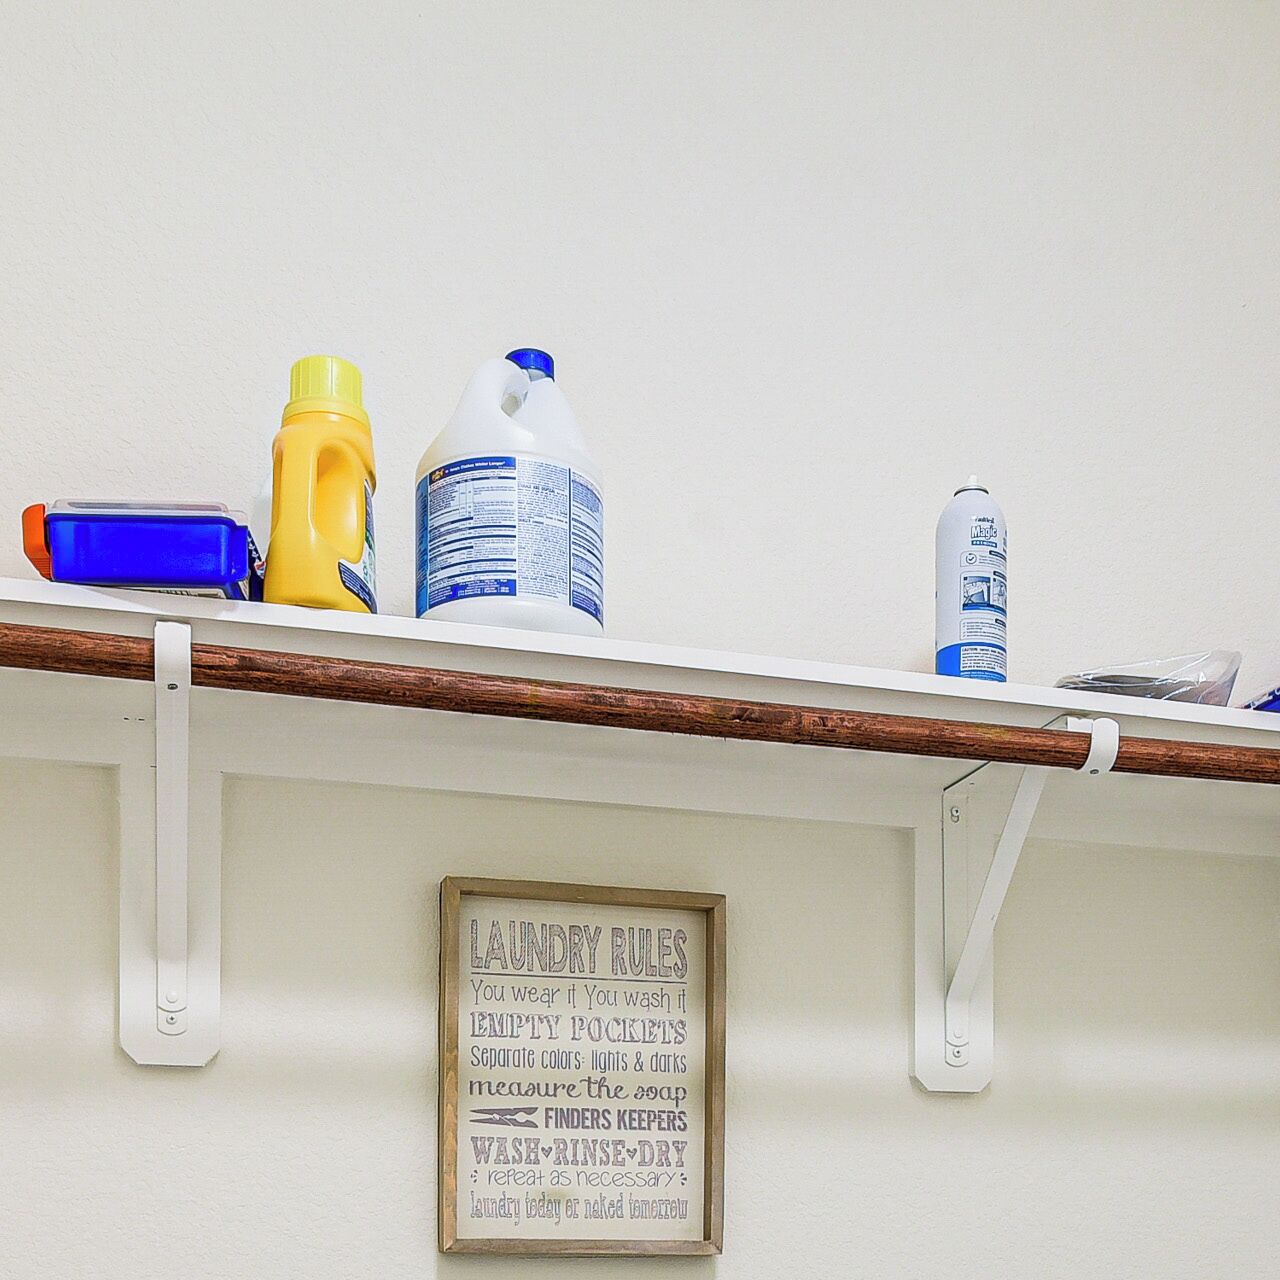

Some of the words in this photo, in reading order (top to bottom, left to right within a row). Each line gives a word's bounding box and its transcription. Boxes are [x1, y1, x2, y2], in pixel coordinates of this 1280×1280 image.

[971, 525, 997, 540] Magic
[471, 919, 602, 974] LAUNDRY
[611, 927, 688, 979] RULES
[470, 979, 505, 1005] You
[512, 986, 560, 1008] wear
[568, 983, 576, 1008] it
[584, 984, 617, 1010] You
[624, 988, 670, 1013] wash
[678, 989, 686, 1013] it
[470, 1011, 562, 1040] EMPTY
[571, 1016, 688, 1045] POCKETS
[470, 1045, 535, 1070] Separate
[541, 1048, 585, 1070] colors:
[591, 1051, 628, 1073] lights
[634, 1051, 644, 1072] &
[650, 1052, 687, 1074] darks
[469, 1079, 581, 1098] measure
[580, 1076, 629, 1099] the
[633, 1085, 687, 1108] soap
[544, 1107, 612, 1130] FINDERS
[617, 1108, 688, 1132] KEEPERS
[470, 1136, 541, 1165] WASH
[553, 1138, 626, 1167] RINSE
[637, 1140, 688, 1168] DRY
[488, 1168, 545, 1187] repeat
[550, 1170, 571, 1186] as
[576, 1170, 677, 1187] necessary
[470, 1191, 520, 1226] laundry
[525, 1192, 562, 1225] today
[566, 1198, 580, 1219] or
[584, 1192, 624, 1220] naked
[629, 1192, 688, 1220] tomorrow
